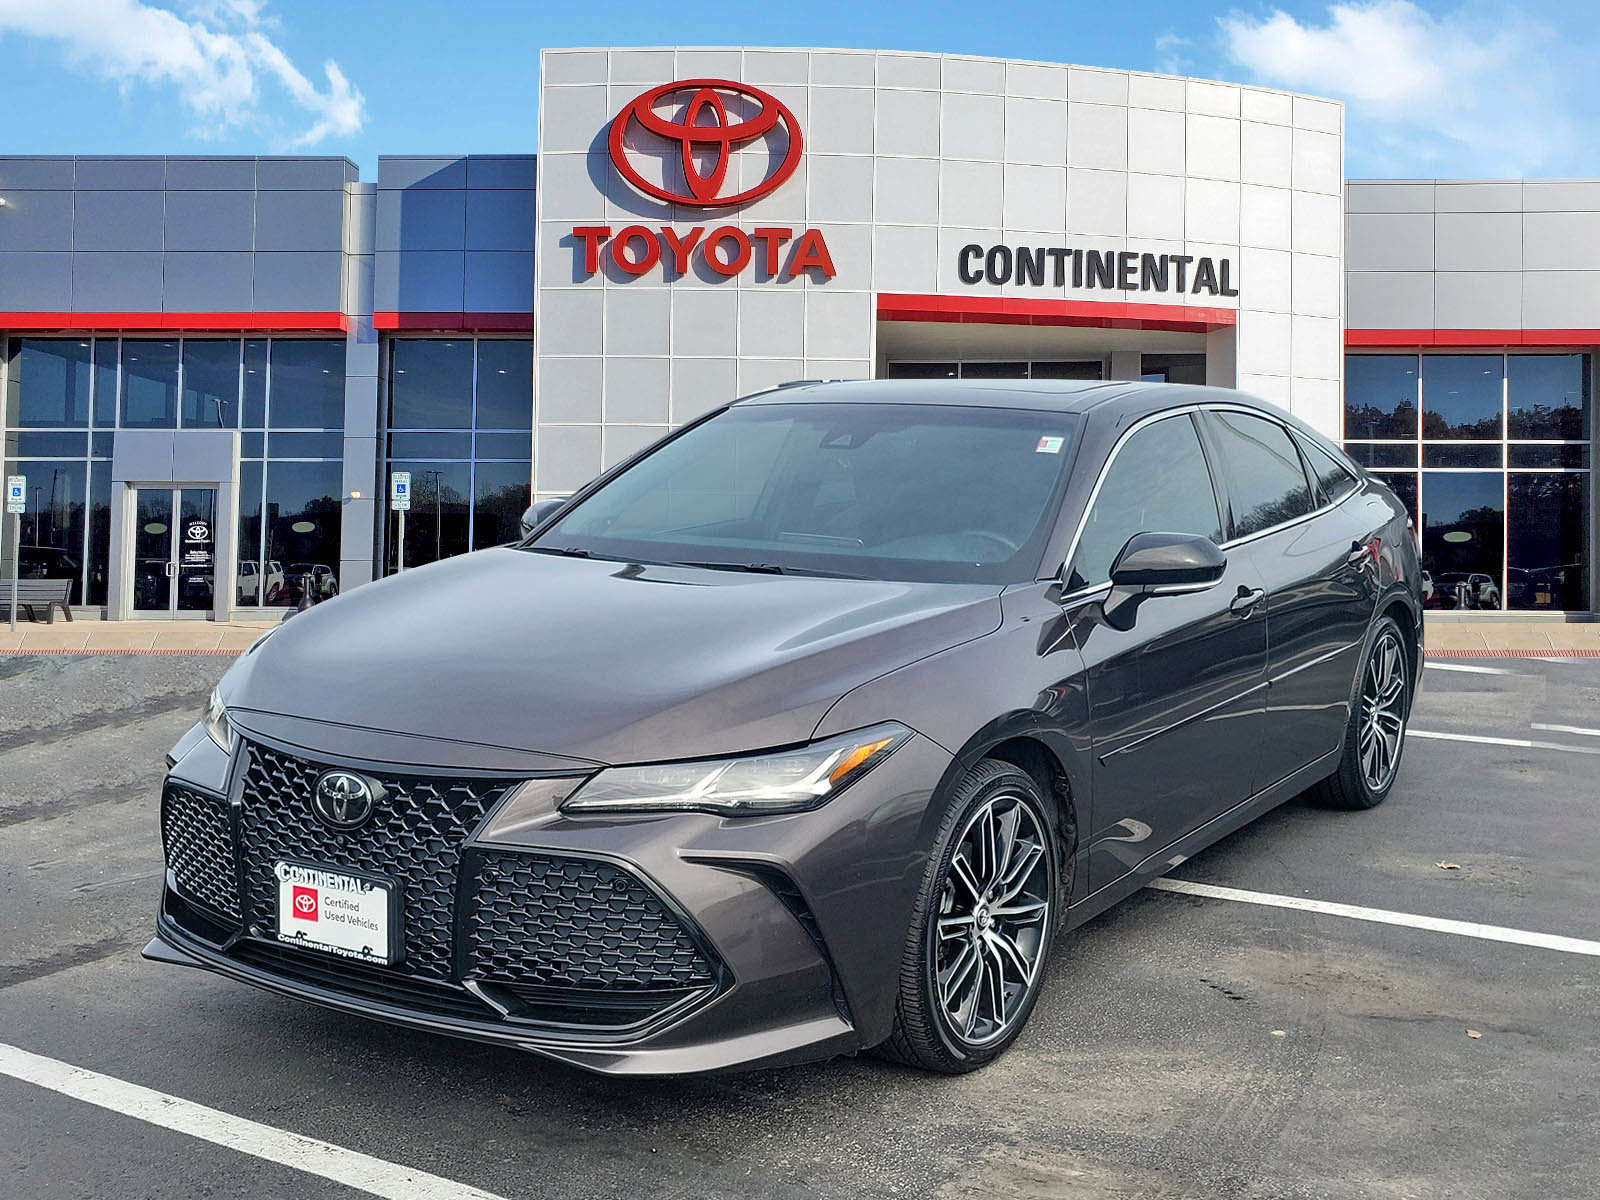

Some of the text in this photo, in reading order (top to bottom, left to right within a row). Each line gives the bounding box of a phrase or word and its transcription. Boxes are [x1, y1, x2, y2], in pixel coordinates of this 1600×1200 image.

[573, 225, 837, 277] TOYOTA
[959, 244, 1239, 297] CONTINENTAL
[275, 862, 367, 895] CONTINENTAL
[324, 896, 360, 912] Certified
[324, 911, 379, 931] Used Vehicles
[277, 934, 388, 966] ContinentalToyota.com
